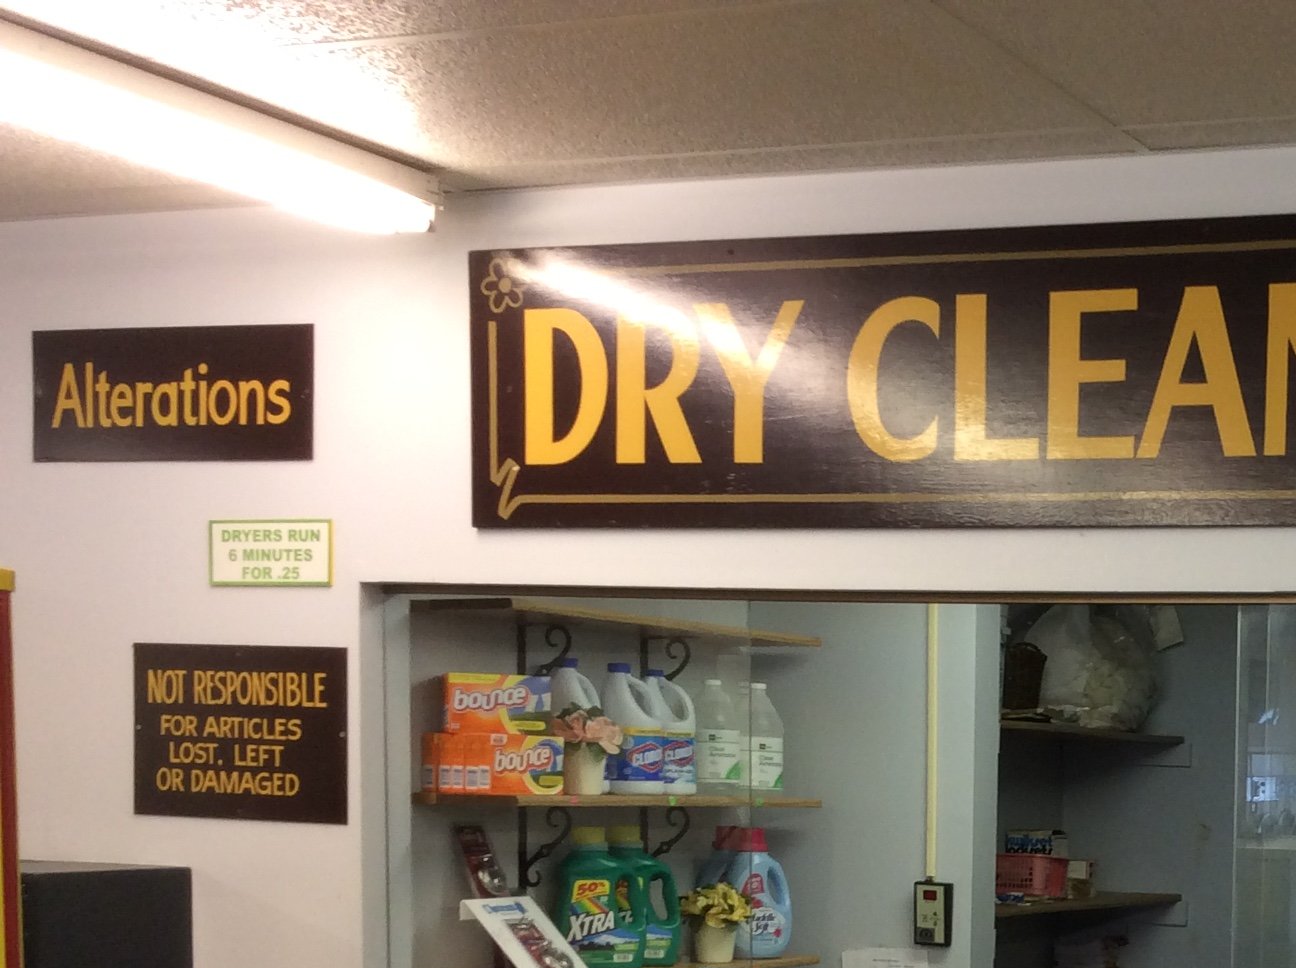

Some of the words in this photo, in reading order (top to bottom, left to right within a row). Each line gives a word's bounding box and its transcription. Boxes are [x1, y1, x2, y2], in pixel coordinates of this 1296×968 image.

[51, 361, 292, 429] Alterations
[522, 298, 804, 467] DRY
[220, 528, 284, 544] DRYERS
[287, 528, 321, 543] RUN
[228, 549, 238, 562] 6
[242, 548, 314, 563] MINUTES
[241, 566, 274, 581] FOR
[277, 566, 301, 581] .25
[147, 669, 187, 704] NOT
[193, 670, 328, 708] RESPONSIBLE
[454, 685, 526, 711] bounce
[160, 714, 198, 737] FOR
[203, 716, 302, 741] ARTICLES
[234, 744, 284, 768] LEFT
[494, 747, 551, 772] bounce
[156, 768, 185, 792] OR
[191, 770, 300, 797] DAMAGED
[565, 910, 616, 943] XTRA
